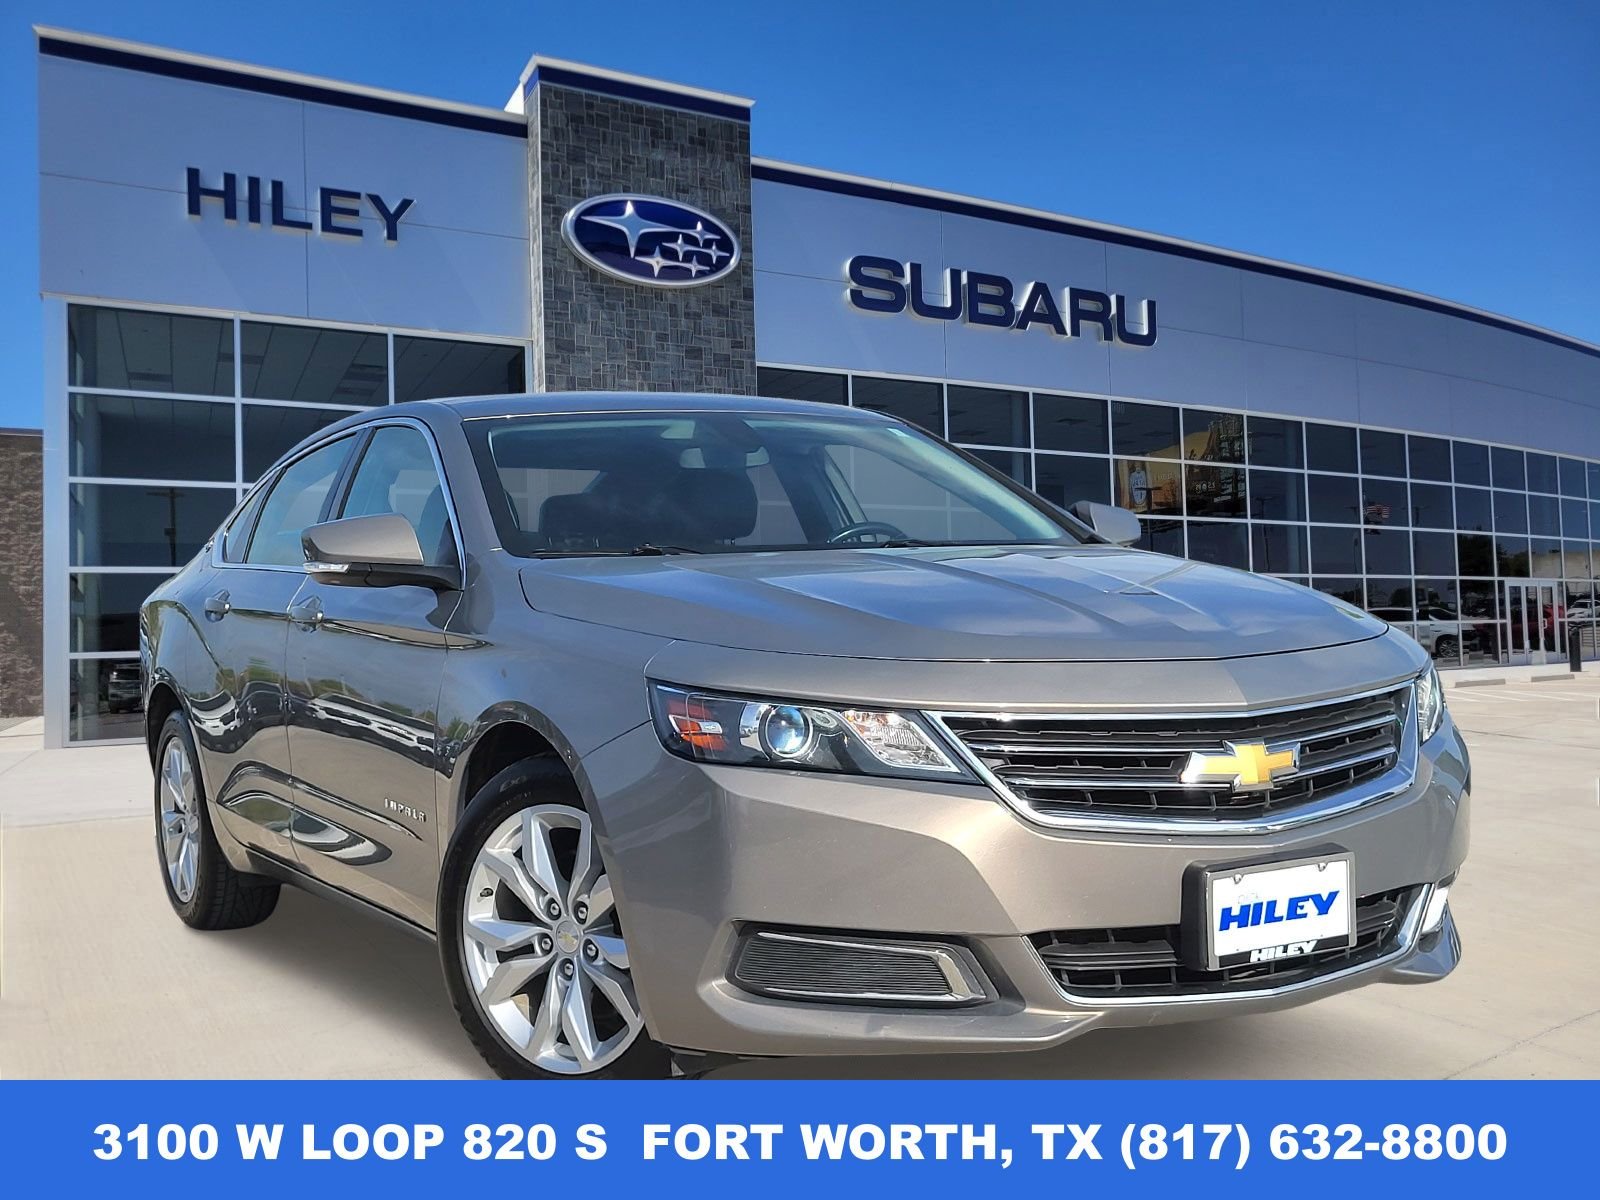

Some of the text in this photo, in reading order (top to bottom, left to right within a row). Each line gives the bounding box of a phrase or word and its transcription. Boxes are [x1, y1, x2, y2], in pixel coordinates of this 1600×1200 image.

[186, 166, 415, 242] HILEY
[847, 254, 1158, 347] SUBARU
[384, 798, 427, 823] IMPALA
[1219, 890, 1340, 931] HILEY
[1249, 939, 1318, 963] HILEY
